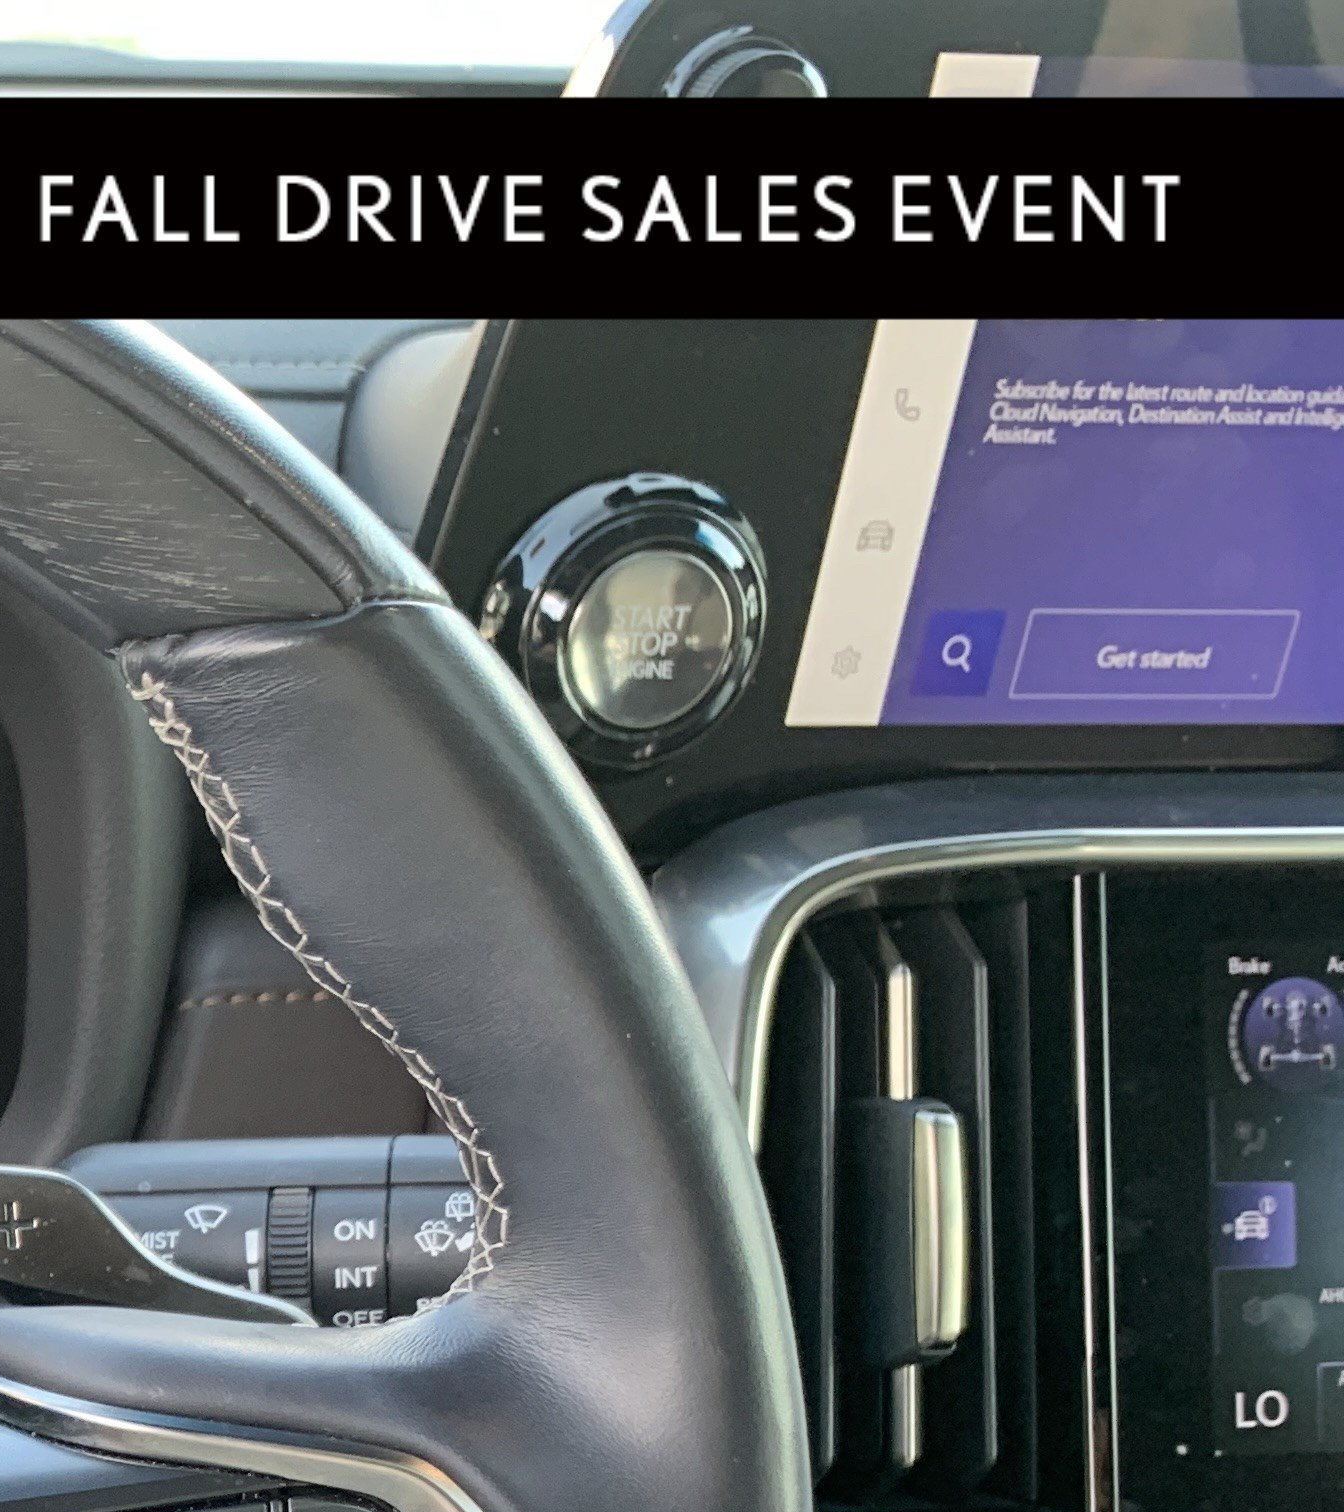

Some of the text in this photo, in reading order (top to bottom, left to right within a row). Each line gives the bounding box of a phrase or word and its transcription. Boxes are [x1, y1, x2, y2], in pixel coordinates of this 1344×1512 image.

[994, 378, 1070, 400] Subscribe
[1072, 380, 1096, 400] for
[1098, 380, 1124, 401] the
[1125, 382, 1168, 401] latest
[1214, 383, 1246, 403] and
[989, 400, 1039, 423] Cloud
[1215, 405, 1261, 426] Assist
[1263, 406, 1293, 426] and
[612, 604, 692, 631] START
[614, 630, 678, 657] TOP
[1097, 645, 1212, 669] Get started
[333, 1219, 376, 1241] ON
[334, 1266, 378, 1290] INT
[332, 1308, 387, 1329] OFF
[1235, 1389, 1290, 1428] LO
